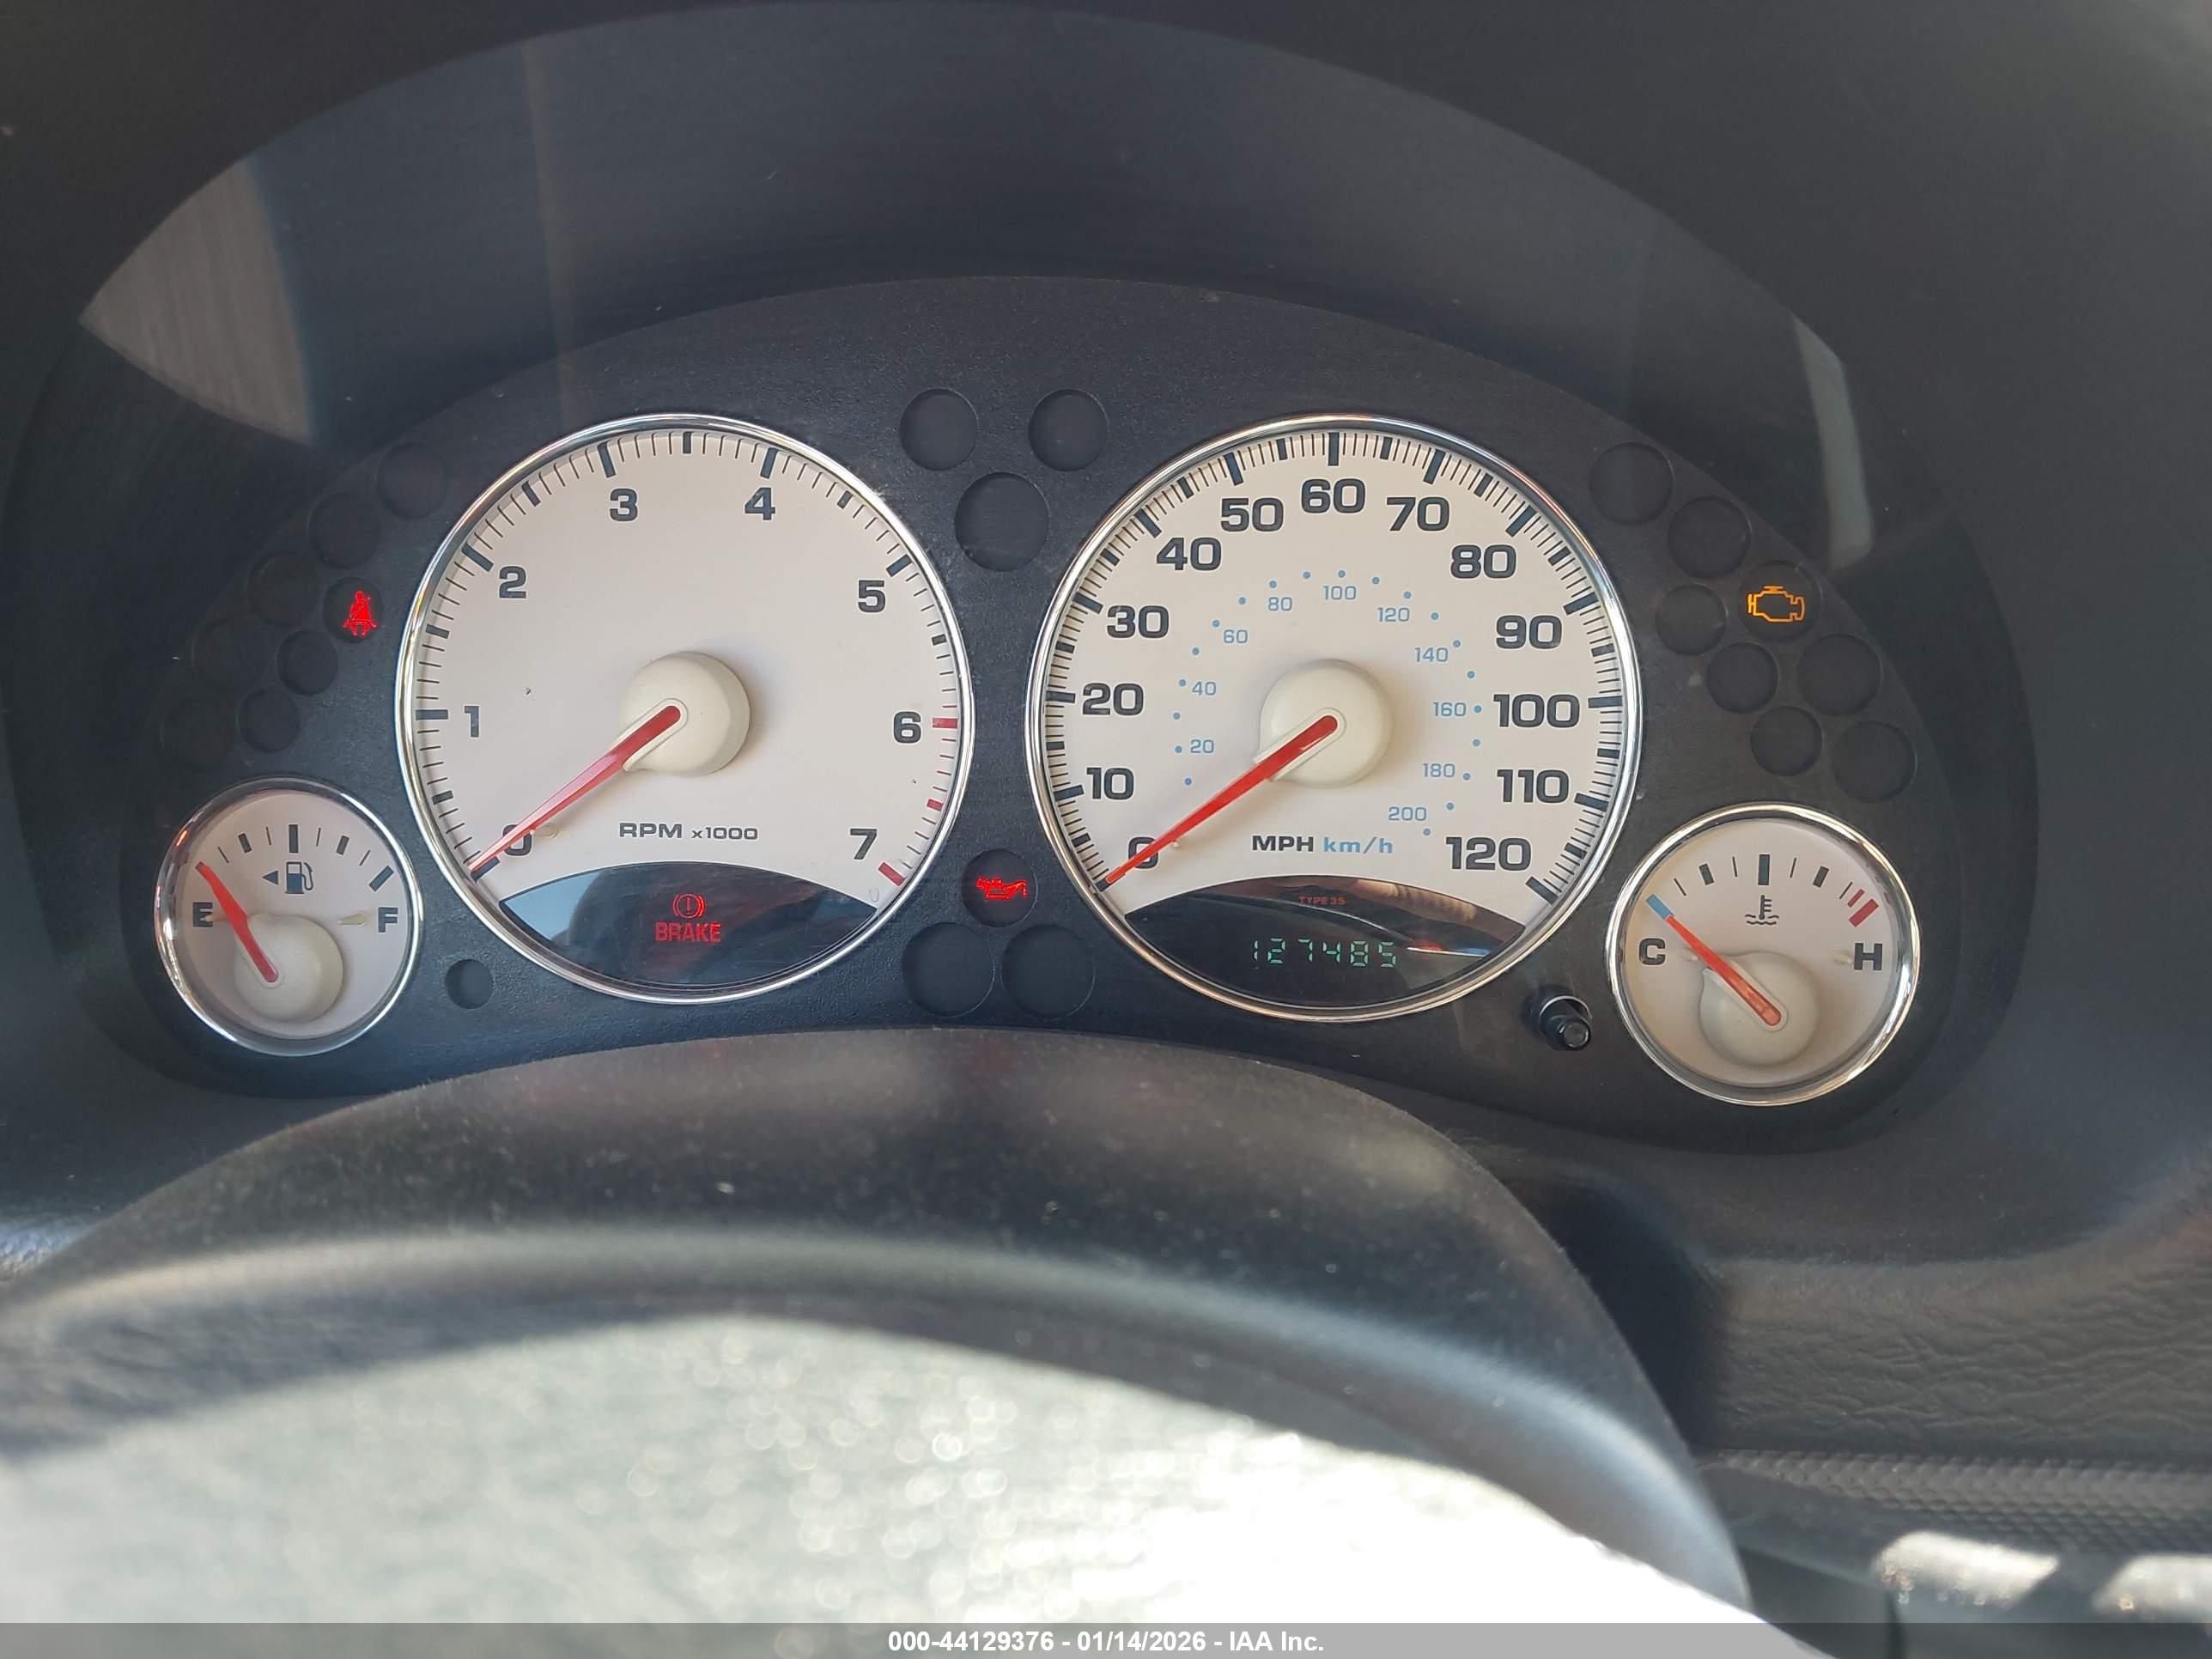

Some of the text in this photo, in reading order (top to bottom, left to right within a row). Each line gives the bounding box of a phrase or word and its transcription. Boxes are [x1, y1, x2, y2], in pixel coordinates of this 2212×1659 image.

[610, 489, 639, 522] 3
[744, 488, 775, 520] 4
[1301, 479, 1365, 513] 60
[1220, 499, 1284, 532] 50
[1386, 497, 1449, 531] 70
[1157, 538, 1221, 570] 40
[1450, 546, 1516, 578] 80
[499, 566, 526, 599] 2
[858, 580, 886, 613] 5
[1322, 585, 1357, 600] 100
[1267, 597, 1292, 611] 80
[1376, 607, 1410, 623] 120
[1107, 605, 1169, 638] 30
[1223, 629, 1249, 644] 60
[1496, 617, 1562, 648] 90
[1414, 647, 1448, 663] 140
[1082, 684, 1144, 715] 20
[1192, 682, 1217, 696] 40
[464, 707, 480, 738] 1
[1433, 702, 1467, 717] 160
[1493, 694, 1579, 727] 100
[892, 712, 921, 744] 6
[1189, 739, 1215, 754] 20
[1086, 768, 1134, 800] 10
[1423, 763, 1455, 778] 180
[1497, 770, 1569, 803] 110
[1389, 806, 1427, 821] 200
[618, 823, 758, 840] RPM x1000
[849, 829, 878, 860] 7
[1251, 836, 1393, 854] MPH km/h
[1446, 837, 1530, 870] 120
[192, 902, 213, 927] E
[1298, 896, 1327, 905] TYPE
[378, 907, 398, 933] F
[655, 922, 722, 942] BRAKE
[1254, 938, 1396, 968] 127485
[1639, 939, 1666, 965] C
[1854, 943, 1882, 970] H
